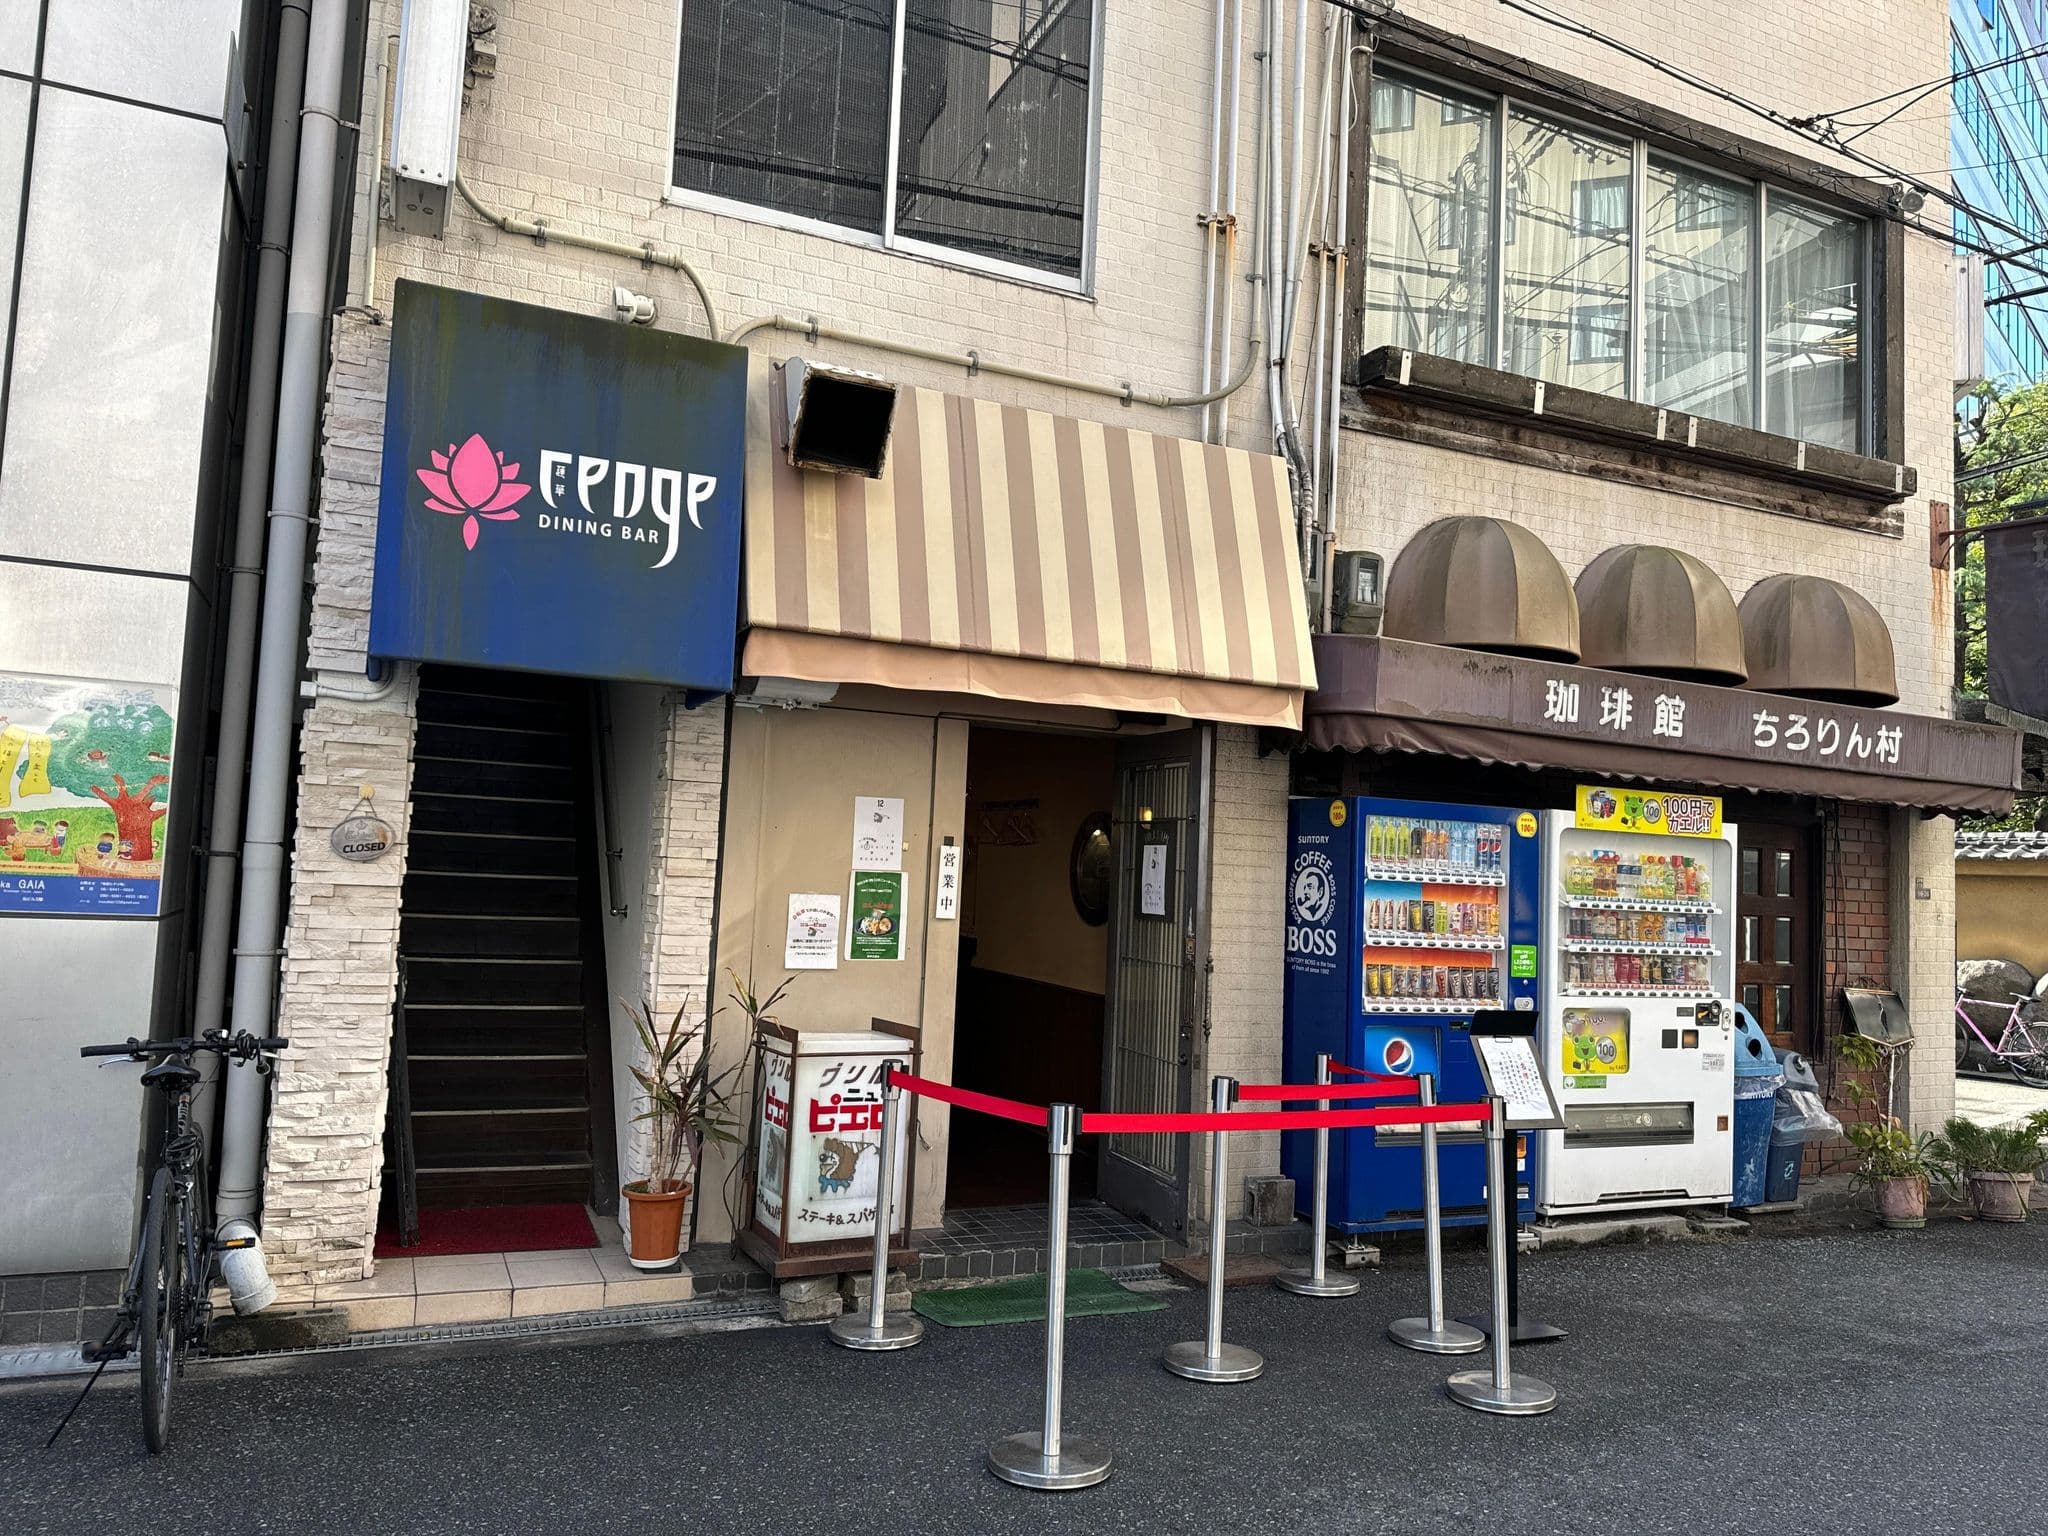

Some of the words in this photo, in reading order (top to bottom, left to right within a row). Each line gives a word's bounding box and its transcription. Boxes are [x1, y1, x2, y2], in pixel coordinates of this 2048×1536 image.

[539, 514, 613, 538] DINING
[621, 526, 660, 544] BAR
[1544, 680, 1686, 738] 珈琲館
[1752, 709, 1903, 764] ちろりん村
[877, 800, 884, 808] 12
[1646, 804, 1659, 818] 100
[1662, 798, 1714, 818] 100円で
[342, 842, 386, 853] CLOSED
[1298, 835, 1330, 844] SUNTORY
[1294, 851, 1333, 873] COFFEE
[18, 879, 46, 890] GAIA
[940, 853, 957, 911] 営業中
[1288, 872, 1298, 903] COFFEE
[1328, 873, 1337, 896] BOSS
[1287, 926, 1337, 957] BOSS
[1598, 1043, 1615, 1057] 100
